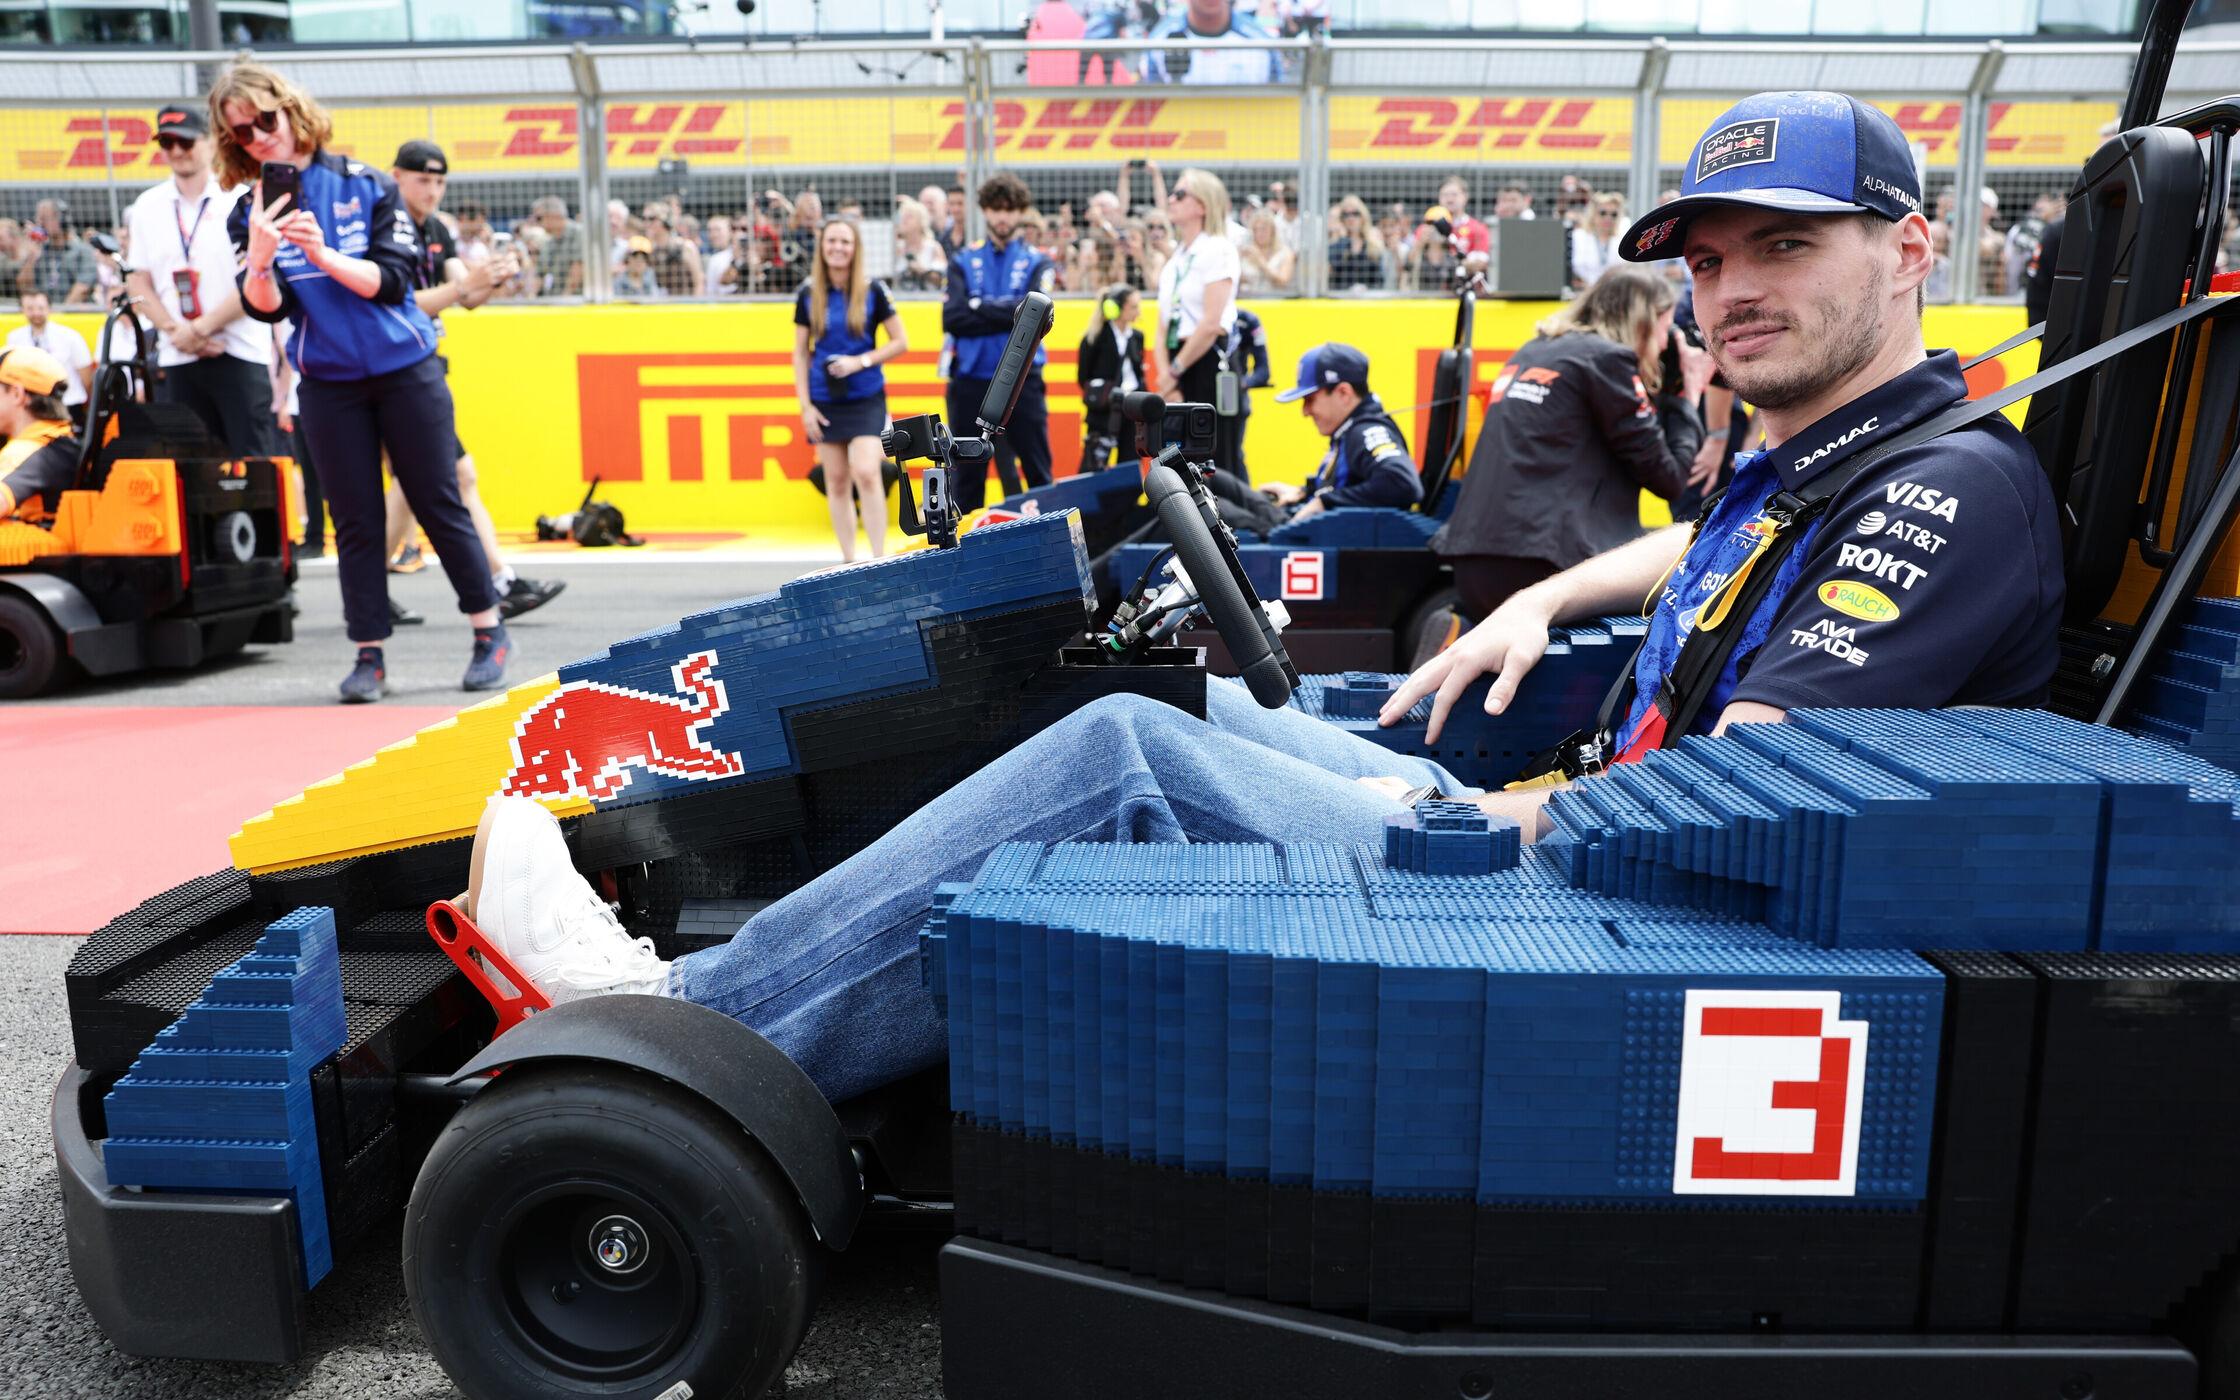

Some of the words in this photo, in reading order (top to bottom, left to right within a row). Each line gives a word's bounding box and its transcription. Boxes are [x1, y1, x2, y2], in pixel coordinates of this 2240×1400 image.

[503, 106, 742, 157] DHL
[938, 98, 1181, 151] DHL
[1370, 100, 1606, 147] DHL
[1706, 125, 1767, 152] ORACLE
[1702, 149, 1764, 173] RACING
[1862, 174, 1921, 213] ALPHATAURI
[1794, 416, 1880, 472] DAMAC
[1884, 481, 1960, 524] VISA
[1885, 519, 1947, 555] AT&T
[1286, 556, 1318, 595] 6
[1836, 542, 1928, 591] ROKT
[1836, 587, 1890, 617] RAUCH
[1789, 629, 1870, 667] TRADE
[1810, 618, 1857, 642] AVA
[1690, 1006, 1852, 1181] 3
